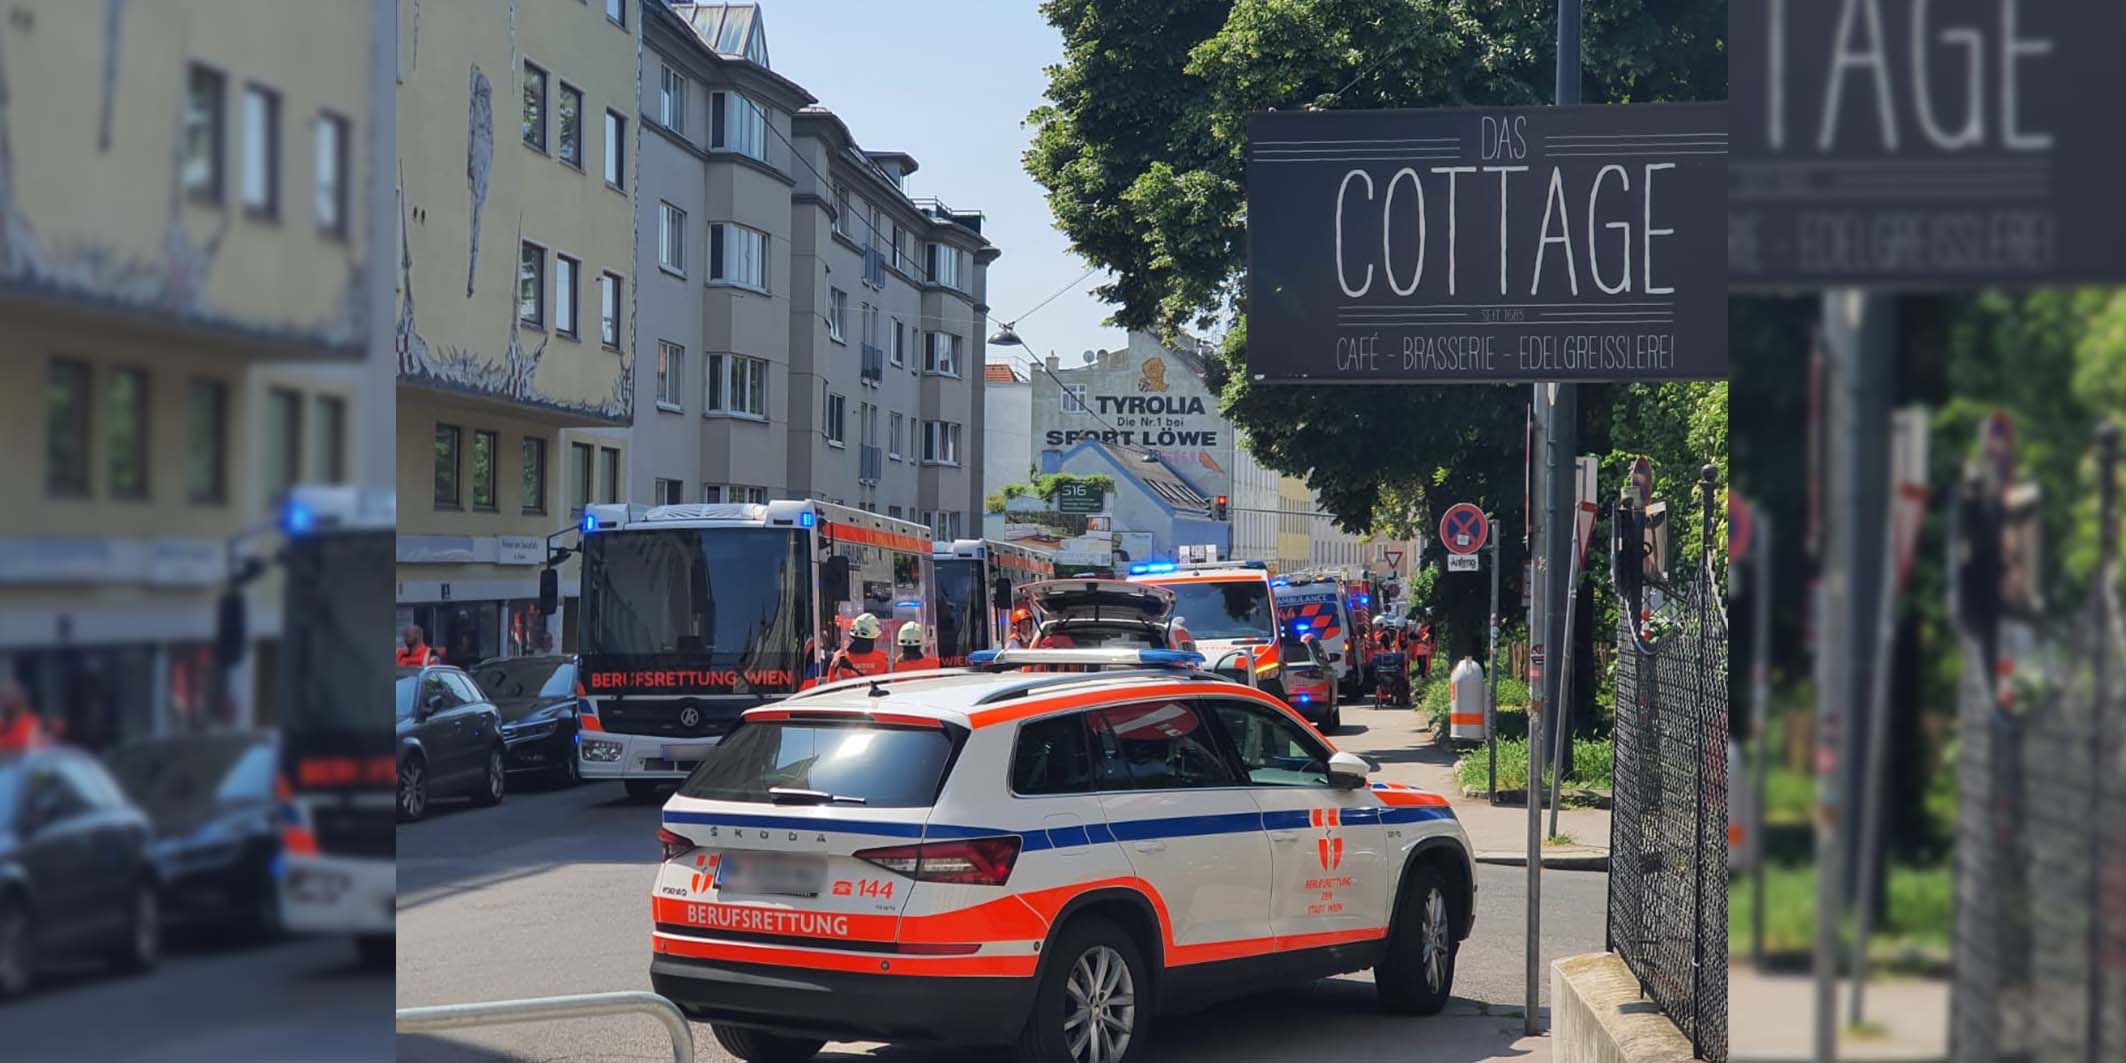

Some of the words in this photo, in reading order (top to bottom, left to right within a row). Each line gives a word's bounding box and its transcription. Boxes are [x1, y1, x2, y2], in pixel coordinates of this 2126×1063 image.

[1481, 115, 1527, 160] DAS
[1335, 163, 1676, 298] COTTAGE
[1337, 331, 1379, 371] CAFÉ
[1402, 335, 1496, 371] BRASSERIE
[1519, 334, 1675, 370] EDELGREISSLEREI
[1095, 395, 1206, 415] TYROLIA
[1117, 416, 1136, 427] Die
[1166, 416, 1184, 427] bei
[1046, 430, 1135, 446] SPORT
[1142, 427, 1217, 446] LÖWE
[1061, 484, 1087, 496] S16
[744, 670, 793, 686] WIEN
[857, 879, 893, 900] 144
[687, 904, 848, 937] BERUFSRETTUNG
